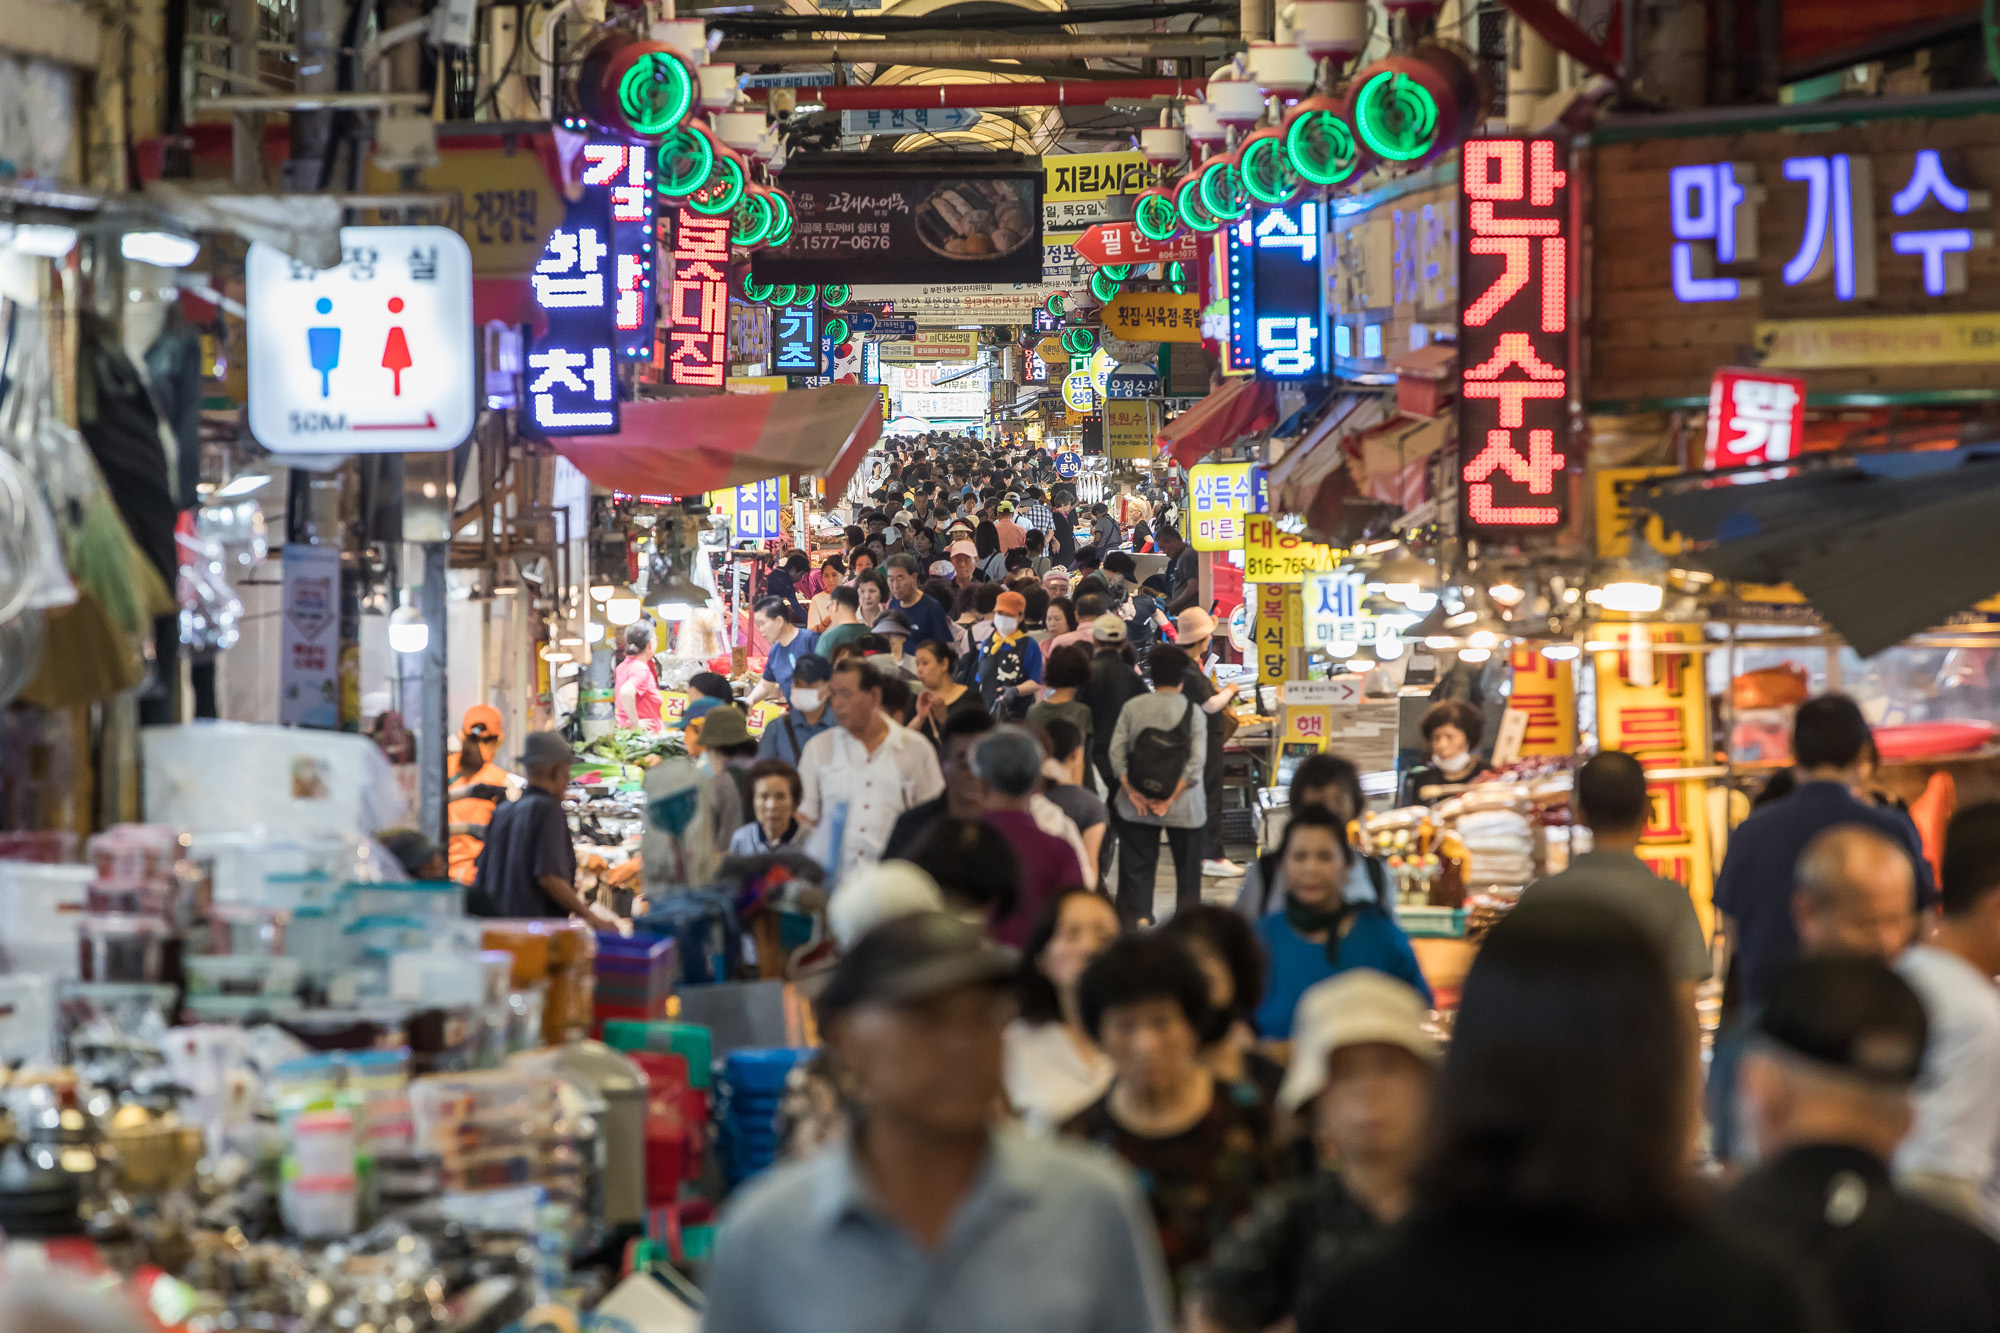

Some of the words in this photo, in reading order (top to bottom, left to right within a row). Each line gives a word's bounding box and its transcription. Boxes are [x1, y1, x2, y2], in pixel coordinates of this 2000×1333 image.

[825, 222, 855, 234] 두꺼비
[857, 222, 877, 234] 쉼터
[1158, 249, 1198, 259] 806-1075
[529, 228, 613, 428] 합천
[1255, 202, 1319, 375] 식당
[1463, 139, 1566, 525] 만기수산
[1060, 463, 1079, 473] 문어
